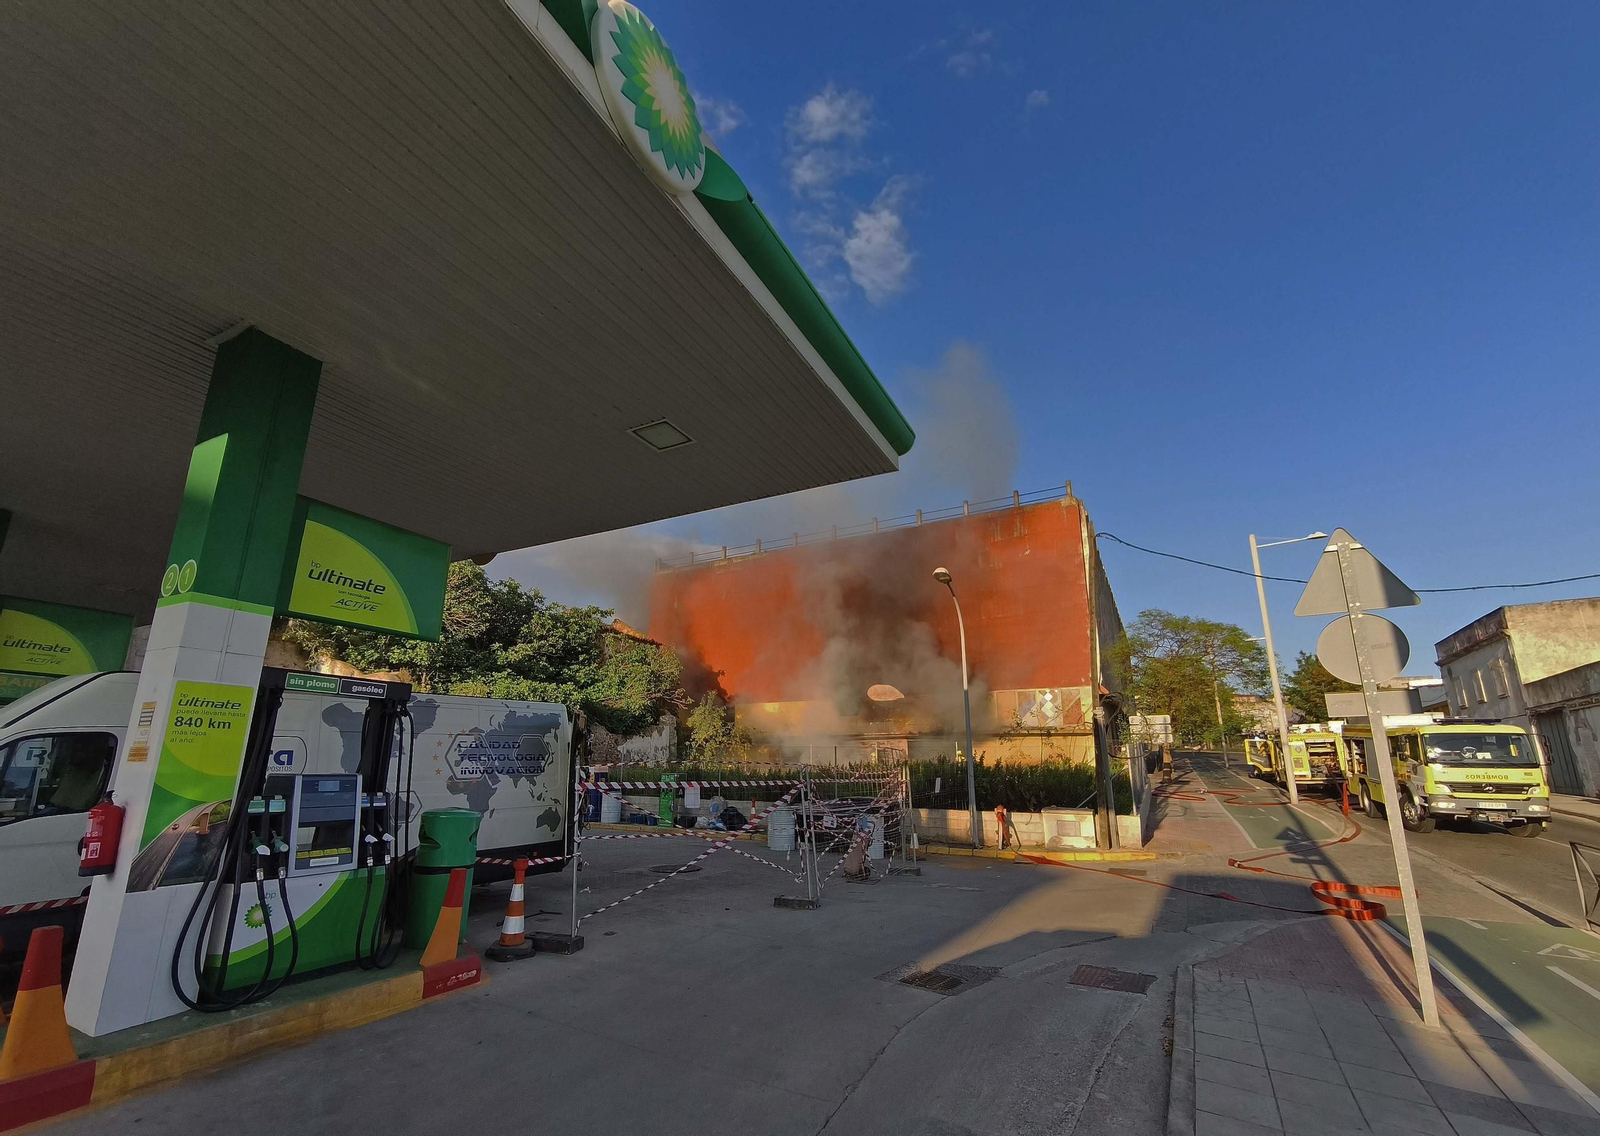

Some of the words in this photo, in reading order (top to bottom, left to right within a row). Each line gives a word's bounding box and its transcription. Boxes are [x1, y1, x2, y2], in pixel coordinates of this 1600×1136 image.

[310, 560, 321, 570] bp
[308, 568, 386, 595] ultimate
[335, 598, 379, 612] ACTIVE
[3, 639, 71, 654] ultimate
[26, 657, 63, 665] ACTIVE
[289, 678, 305, 686] sin
[306, 679, 336, 689] plomo
[351, 684, 384, 694] gasóleo
[178, 697, 241, 710] ultimate
[201, 709, 227, 717] llevarte
[174, 716, 203, 728] 840
[208, 717, 231, 729] km
[190, 729, 207, 737] lejos
[458, 741, 521, 749] CALIDAD
[458, 754, 545, 762] TECNOLOGIA
[460, 766, 546, 775] INNOVACION
